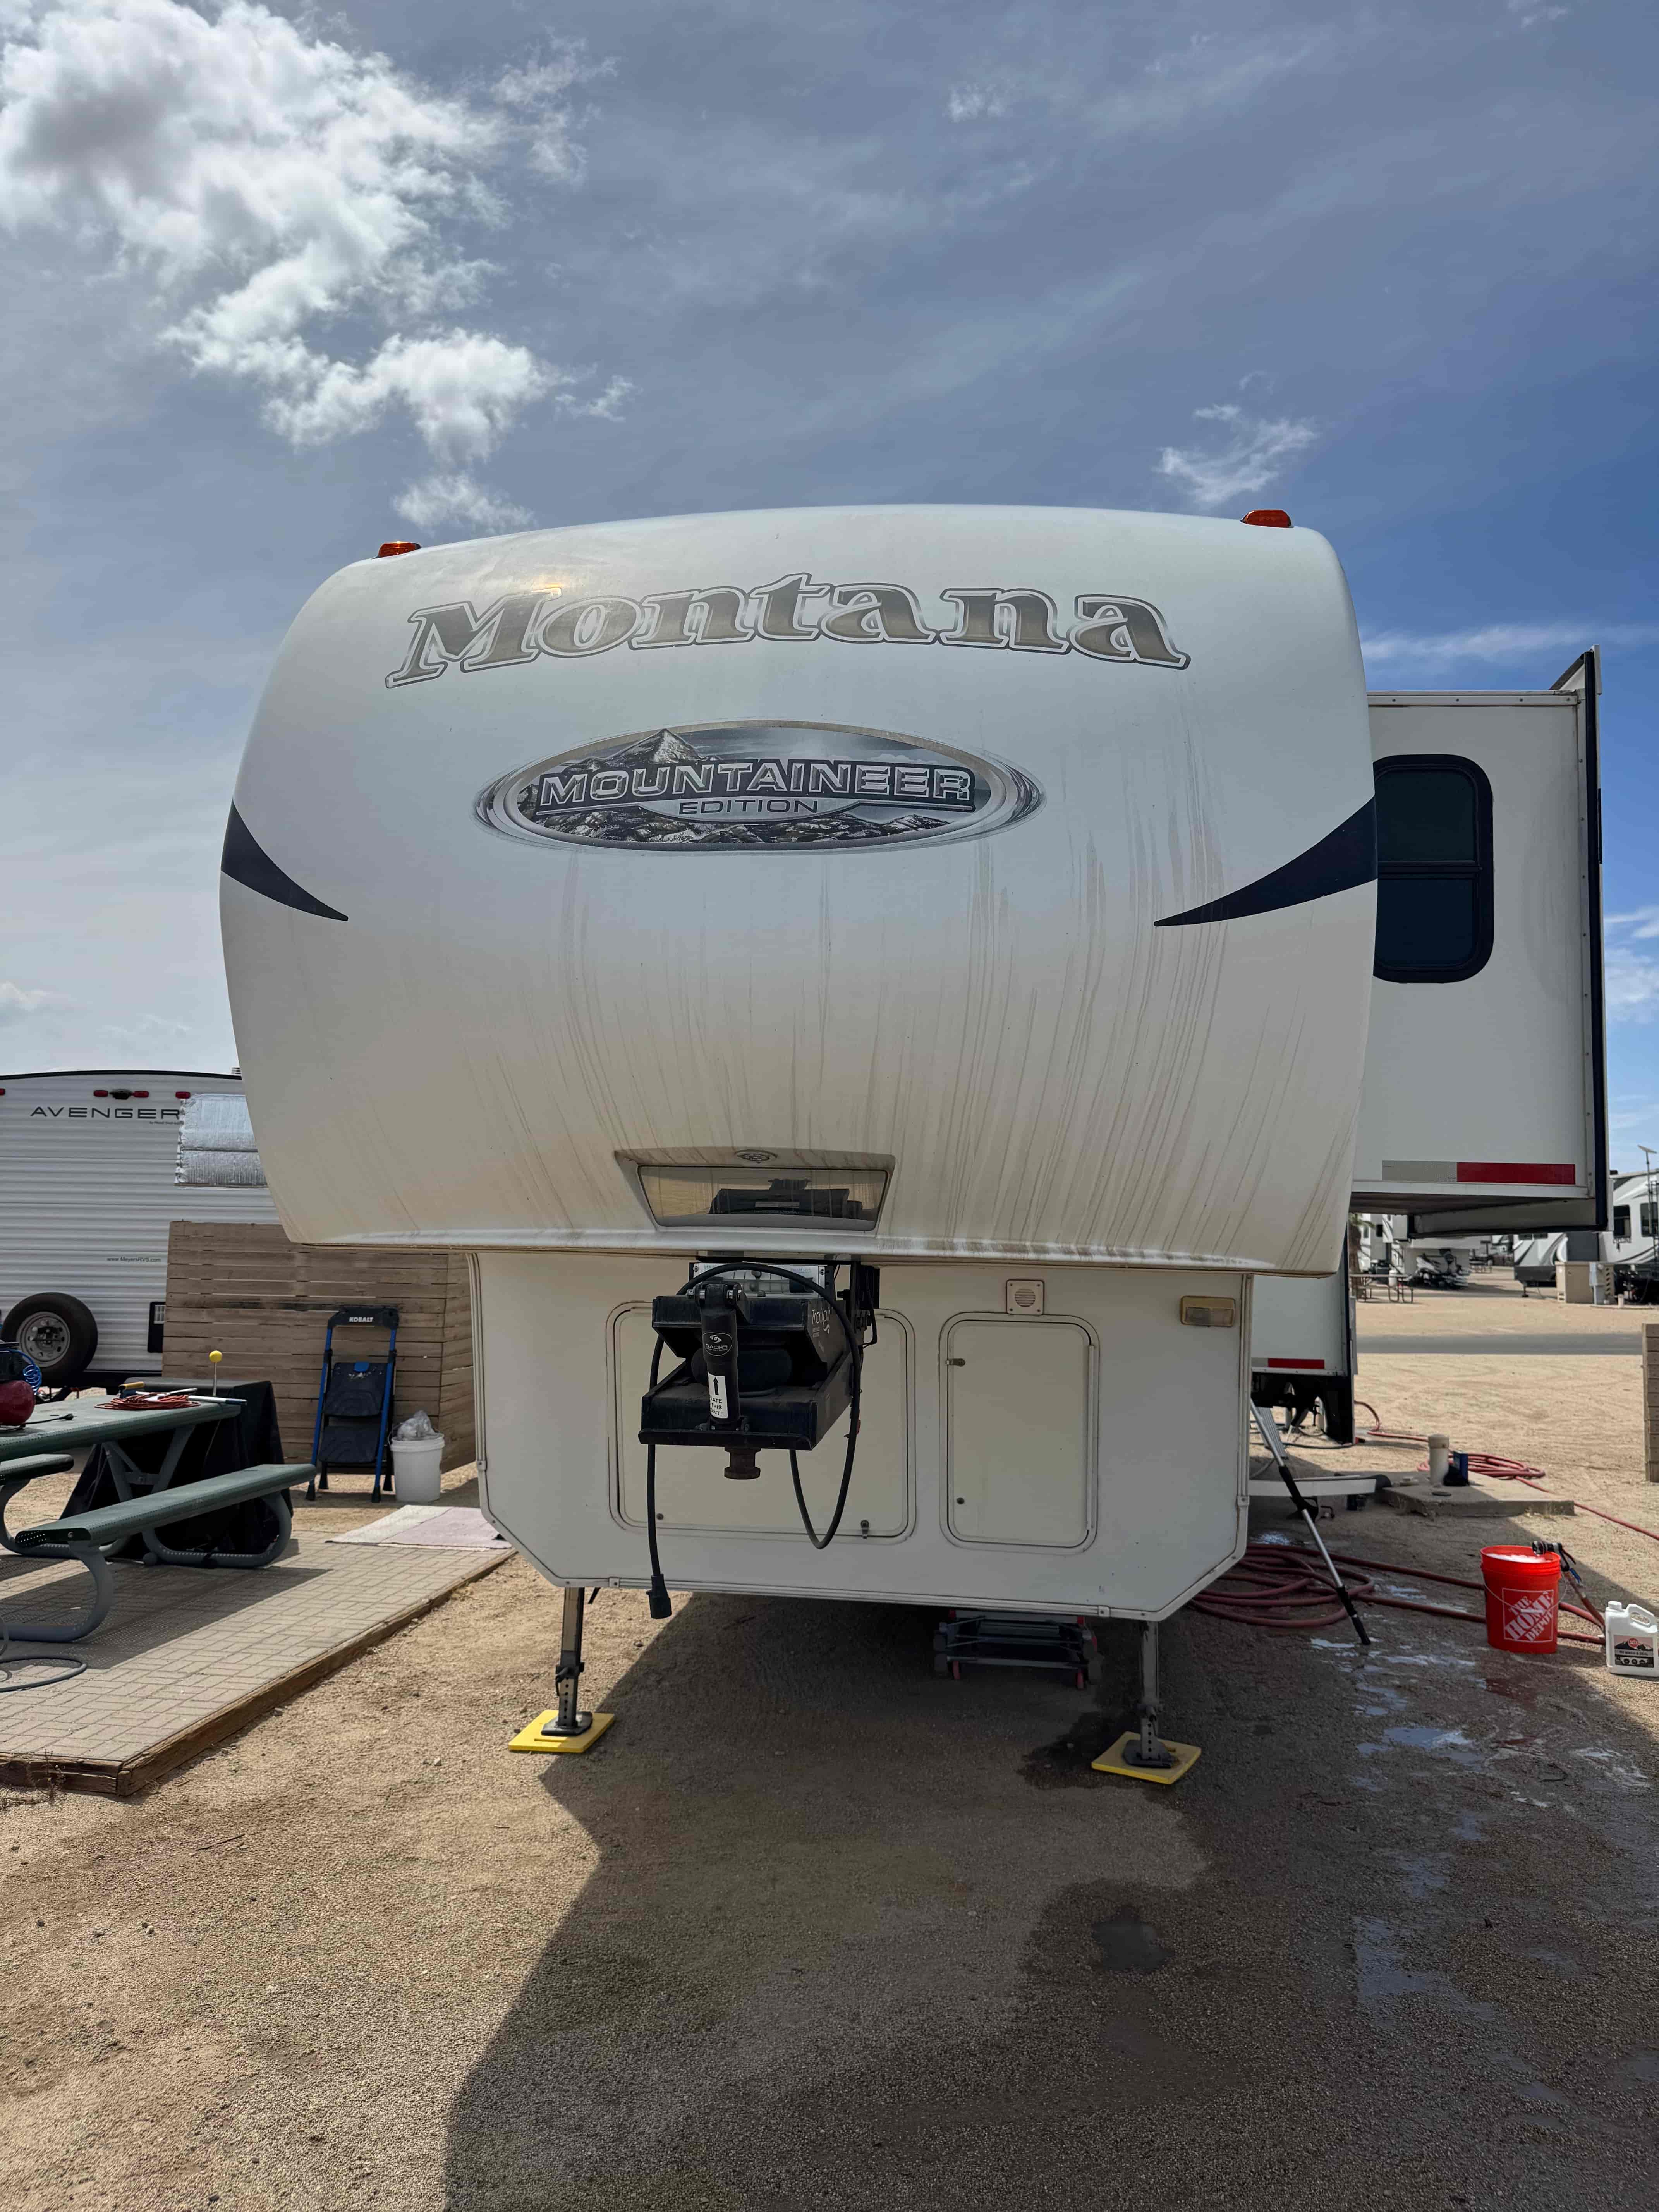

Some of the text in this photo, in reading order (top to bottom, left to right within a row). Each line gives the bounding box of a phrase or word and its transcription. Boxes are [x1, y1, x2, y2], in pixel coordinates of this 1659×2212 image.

[386, 572, 1192, 688] Montana
[539, 761, 972, 806] MOUNTAINEER
[679, 799, 818, 815] EDITION
[30, 1106, 180, 1120] AVENGER
[1505, 1591, 1554, 1640] HOME
[1508, 1595, 1532, 1616] THE
[1524, 1609, 1553, 1642] DEPOT
